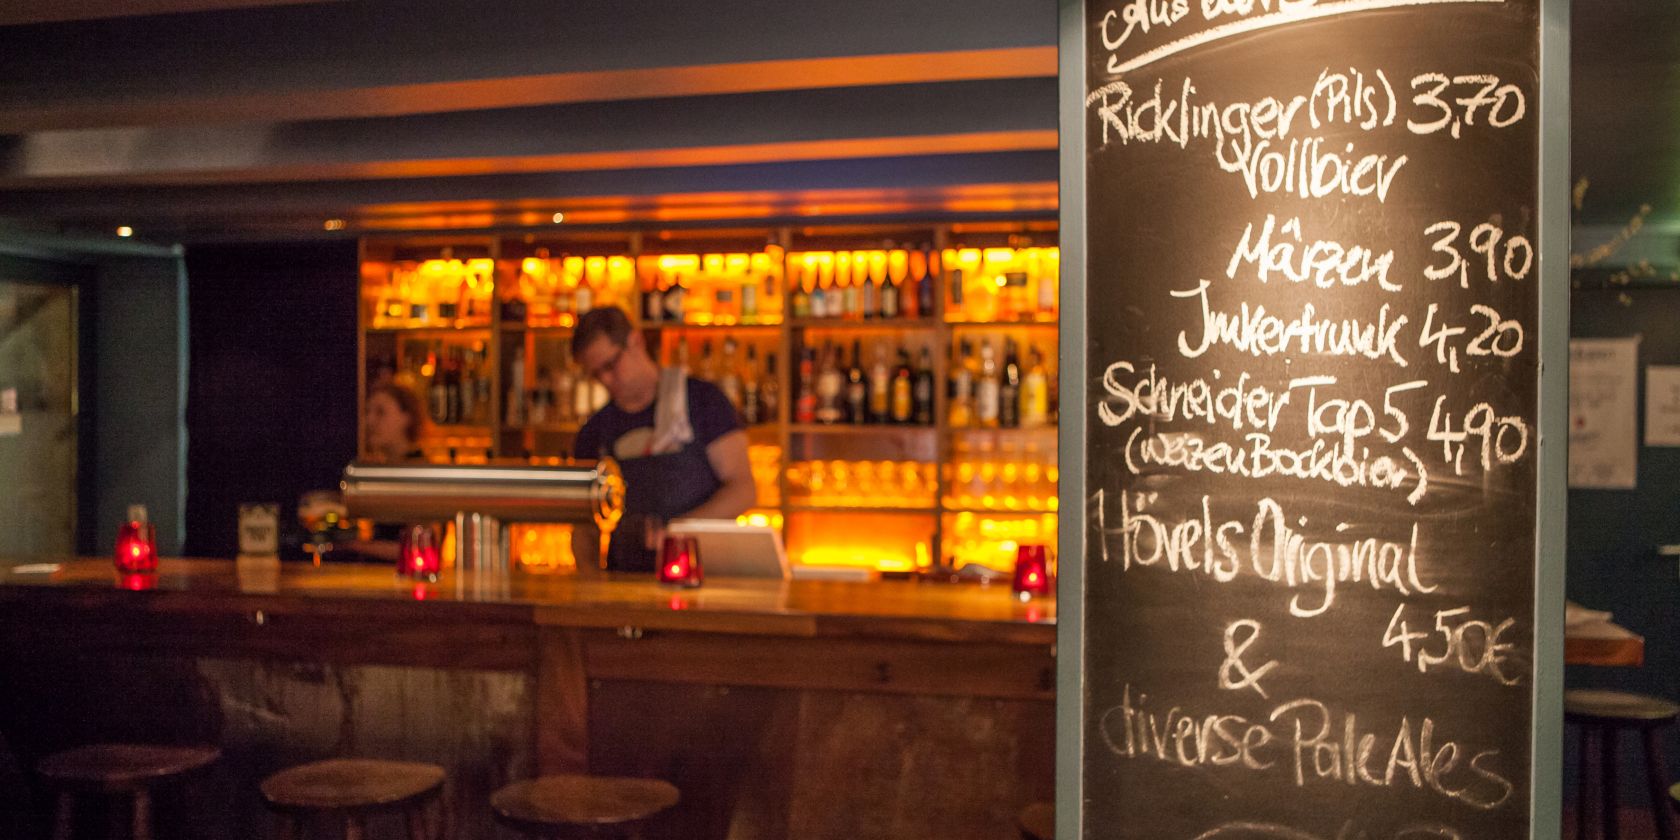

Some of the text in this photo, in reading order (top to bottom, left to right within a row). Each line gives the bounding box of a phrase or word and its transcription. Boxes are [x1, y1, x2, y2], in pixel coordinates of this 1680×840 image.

[1086, 67, 1526, 172] Ricklinger (Pils) 3,70
[1232, 137, 1408, 203] Vollbier
[1423, 221, 1533, 289] 3,90
[1418, 303, 1523, 373] 4,20
[1098, 362, 1527, 475] Schneider Tap 5 4,90
[1090, 488, 1438, 617] Hövels Original
[1218, 619, 1279, 698] &
[1382, 603, 1521, 685] 4,50€
[1101, 683, 1276, 770] diverse
